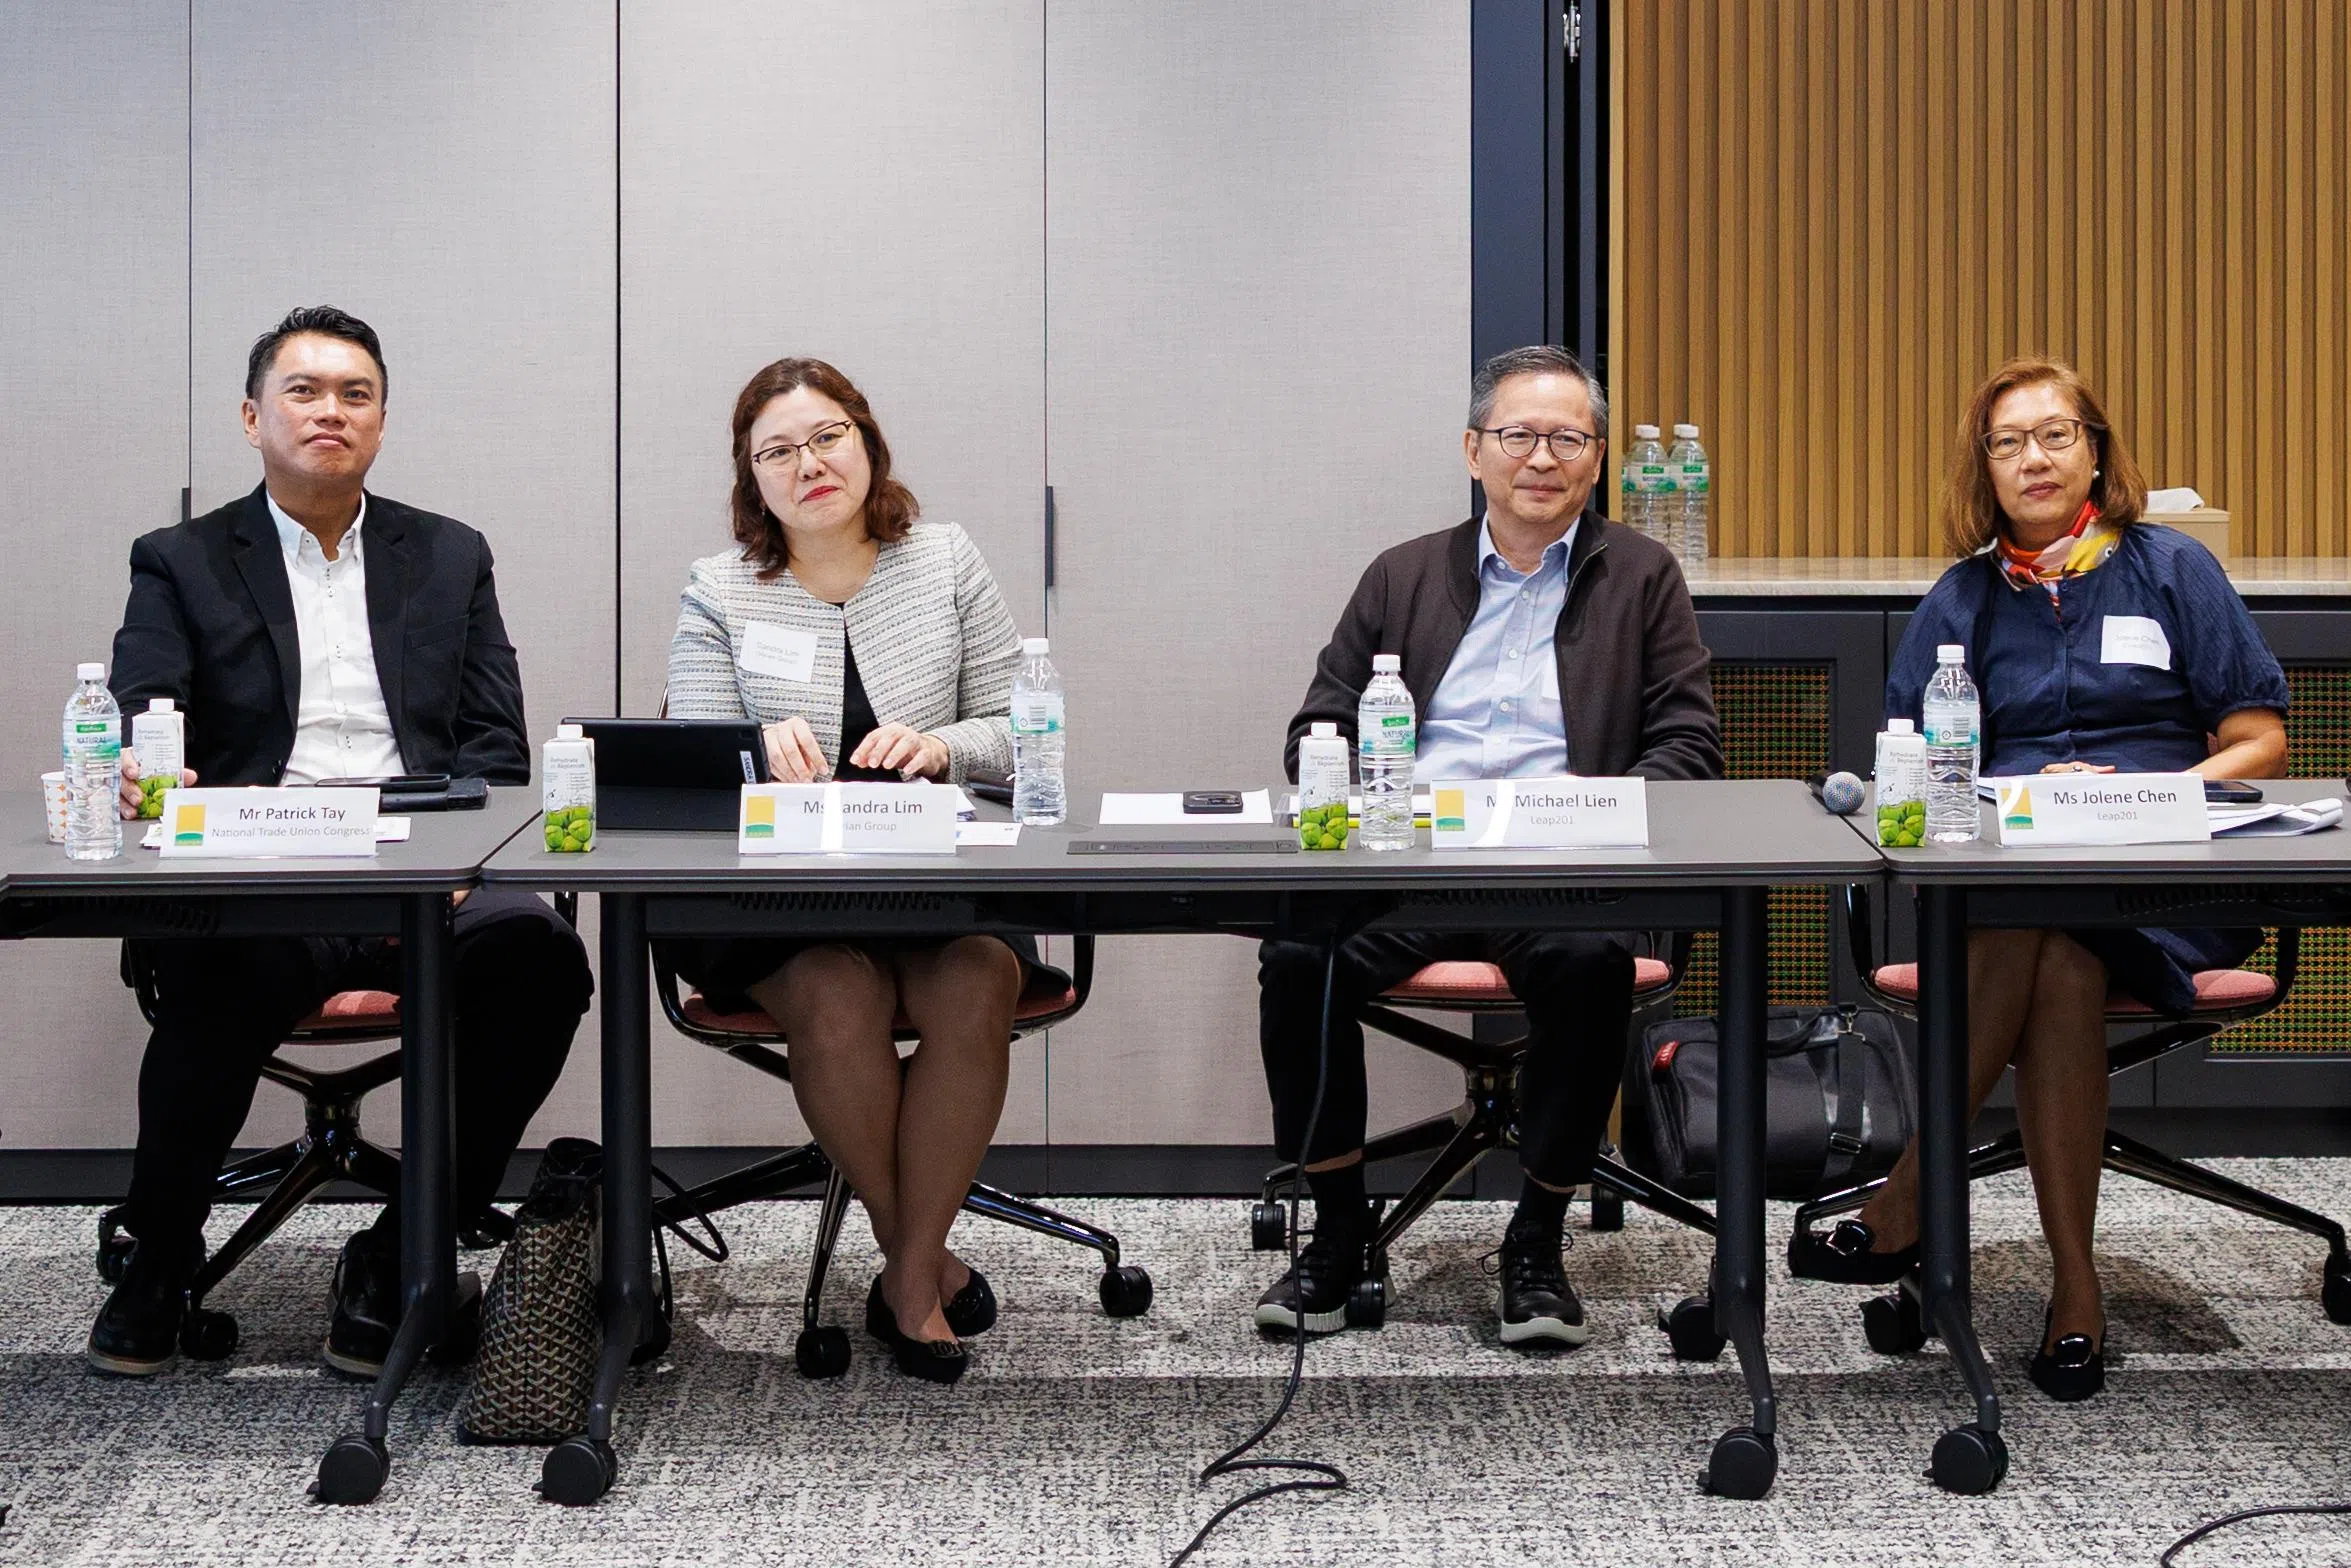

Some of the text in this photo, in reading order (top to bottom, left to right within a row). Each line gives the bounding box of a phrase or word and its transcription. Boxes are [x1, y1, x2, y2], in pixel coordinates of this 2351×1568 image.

[1515, 794, 1579, 808] Michael
[1585, 794, 1618, 807] Lien
[2054, 790, 2177, 804] Ms Jolene Chen
[842, 800, 889, 814] andra
[895, 800, 923, 813] Lim
[239, 807, 346, 821] Mr Patrick Tay
[1530, 815, 1574, 826] Leap201
[2097, 811, 2138, 822] Leap201
[211, 826, 370, 838] National Trade Union Congress
[864, 821, 897, 832] Group
